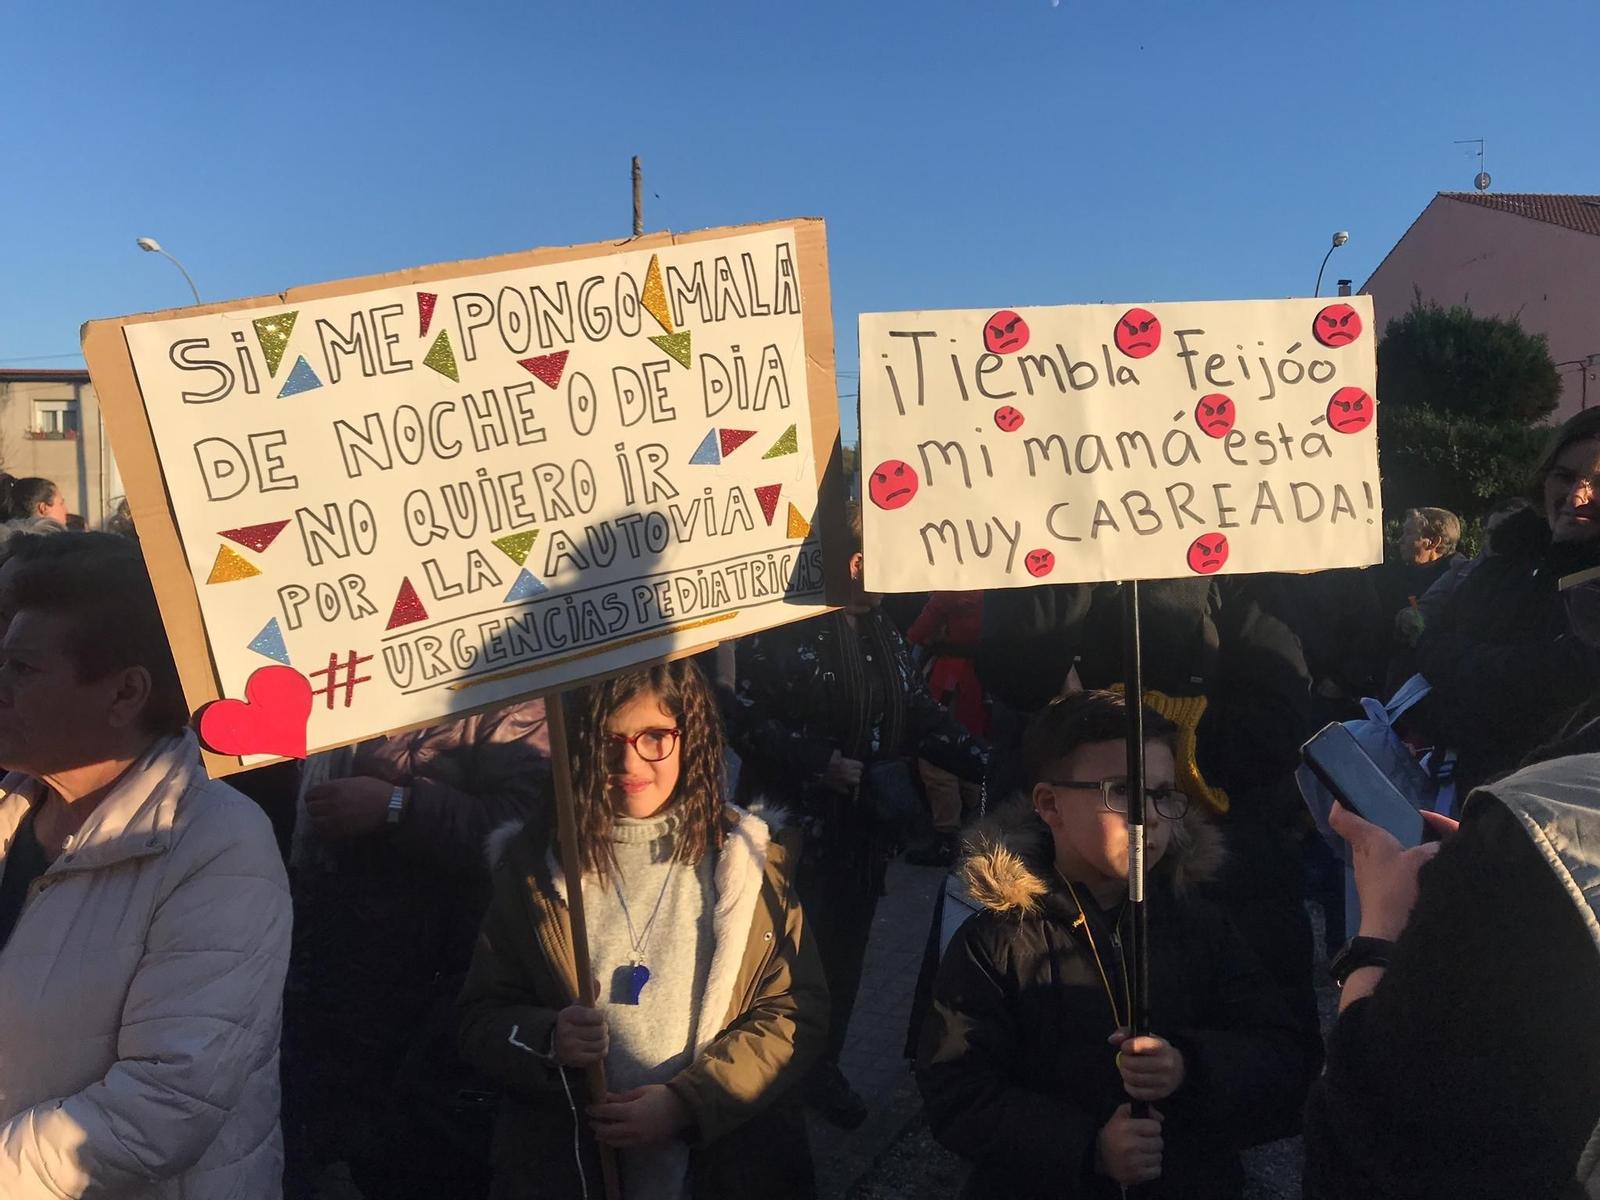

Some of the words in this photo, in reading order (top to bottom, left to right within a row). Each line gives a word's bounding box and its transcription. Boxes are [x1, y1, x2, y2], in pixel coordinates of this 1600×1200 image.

[315, 303, 413, 384] ME
[453, 271, 642, 362] PONGO
[666, 242, 802, 328] MALA
[1174, 328, 1337, 401] Feijóo
[193, 430, 299, 501] DE
[333, 381, 547, 479] NOCHE
[568, 371, 597, 436] O
[612, 359, 676, 427] DE
[917, 427, 993, 489] mi
[1023, 410, 1201, 477] mamá
[1224, 414, 1333, 466] está
[295, 499, 378, 567] NO
[1046, 480, 1374, 542] CABREADA!
[278, 574, 379, 632] POR
[422, 549, 503, 602] LA
